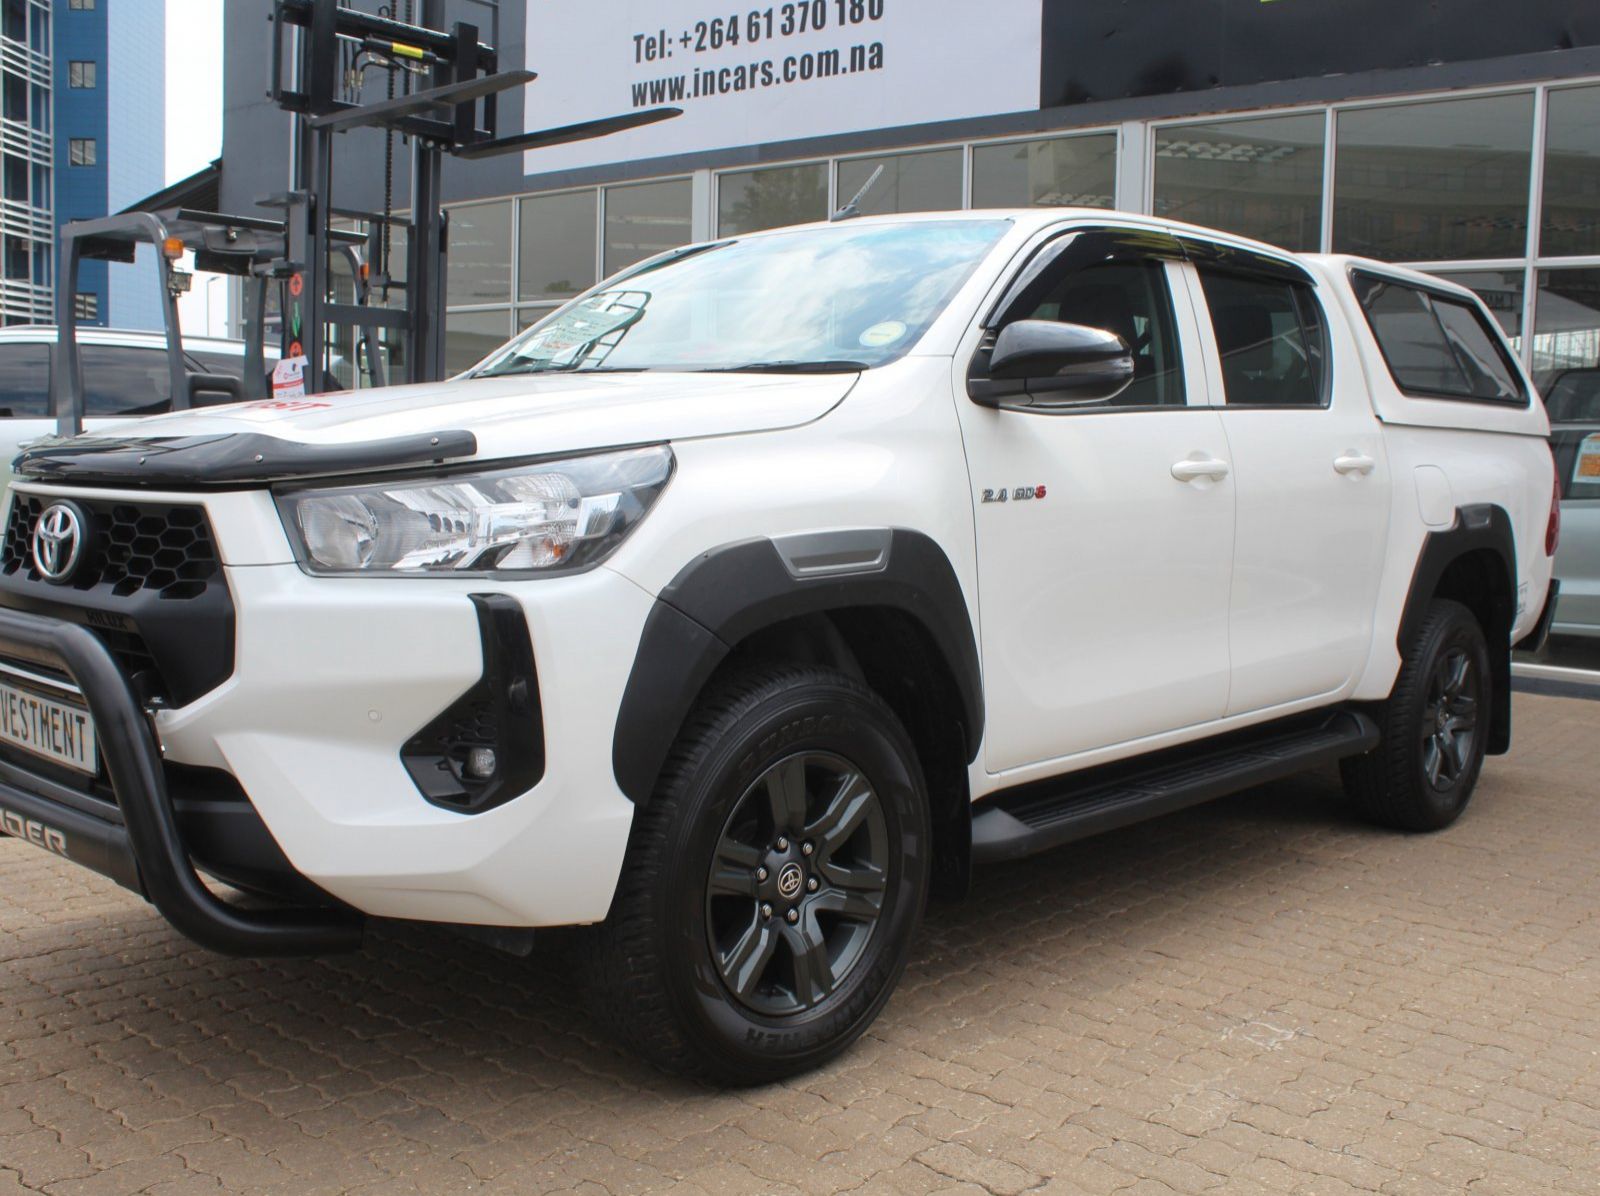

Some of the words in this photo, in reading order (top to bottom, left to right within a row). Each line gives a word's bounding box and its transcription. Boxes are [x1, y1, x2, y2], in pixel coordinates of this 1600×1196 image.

[633, 30, 673, 63] Tel:
[679, 15, 739, 52] +264
[746, 8, 773, 42] 61
[780, 0, 827, 36] 370
[835, 0, 884, 27] 180
[631, 41, 884, 108] www.incars.com.na
[981, 488, 1008, 503] 2.4
